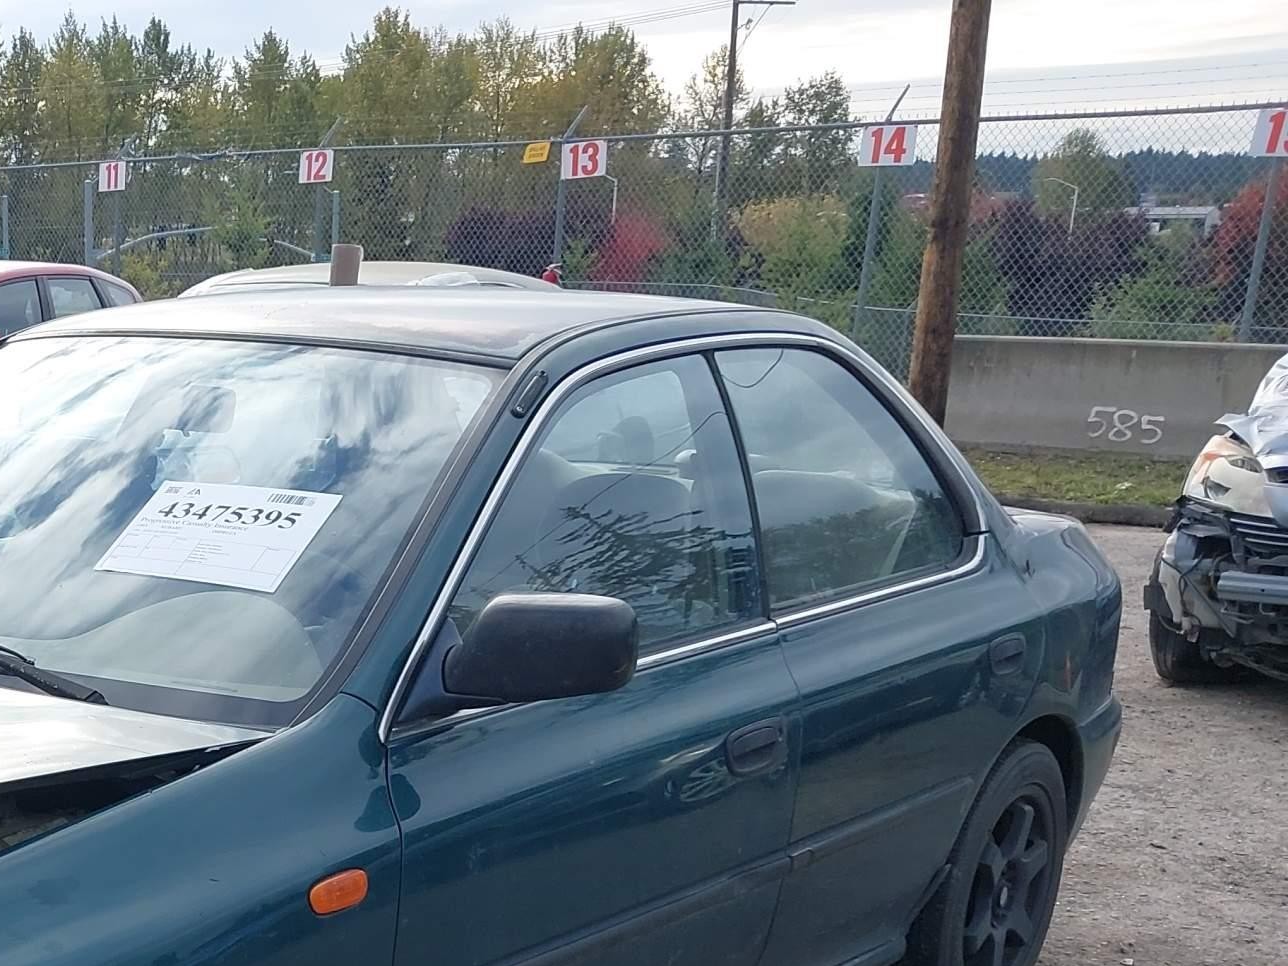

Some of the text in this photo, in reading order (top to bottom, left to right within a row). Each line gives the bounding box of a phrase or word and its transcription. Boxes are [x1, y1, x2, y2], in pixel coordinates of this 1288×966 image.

[872, 126, 906, 164] 14
[1266, 111, 1288, 154] 1
[305, 151, 328, 181] 12
[569, 142, 599, 176] 13
[105, 163, 119, 190] 11
[1088, 406, 1165, 444] 585
[158, 501, 302, 529] 43475395
